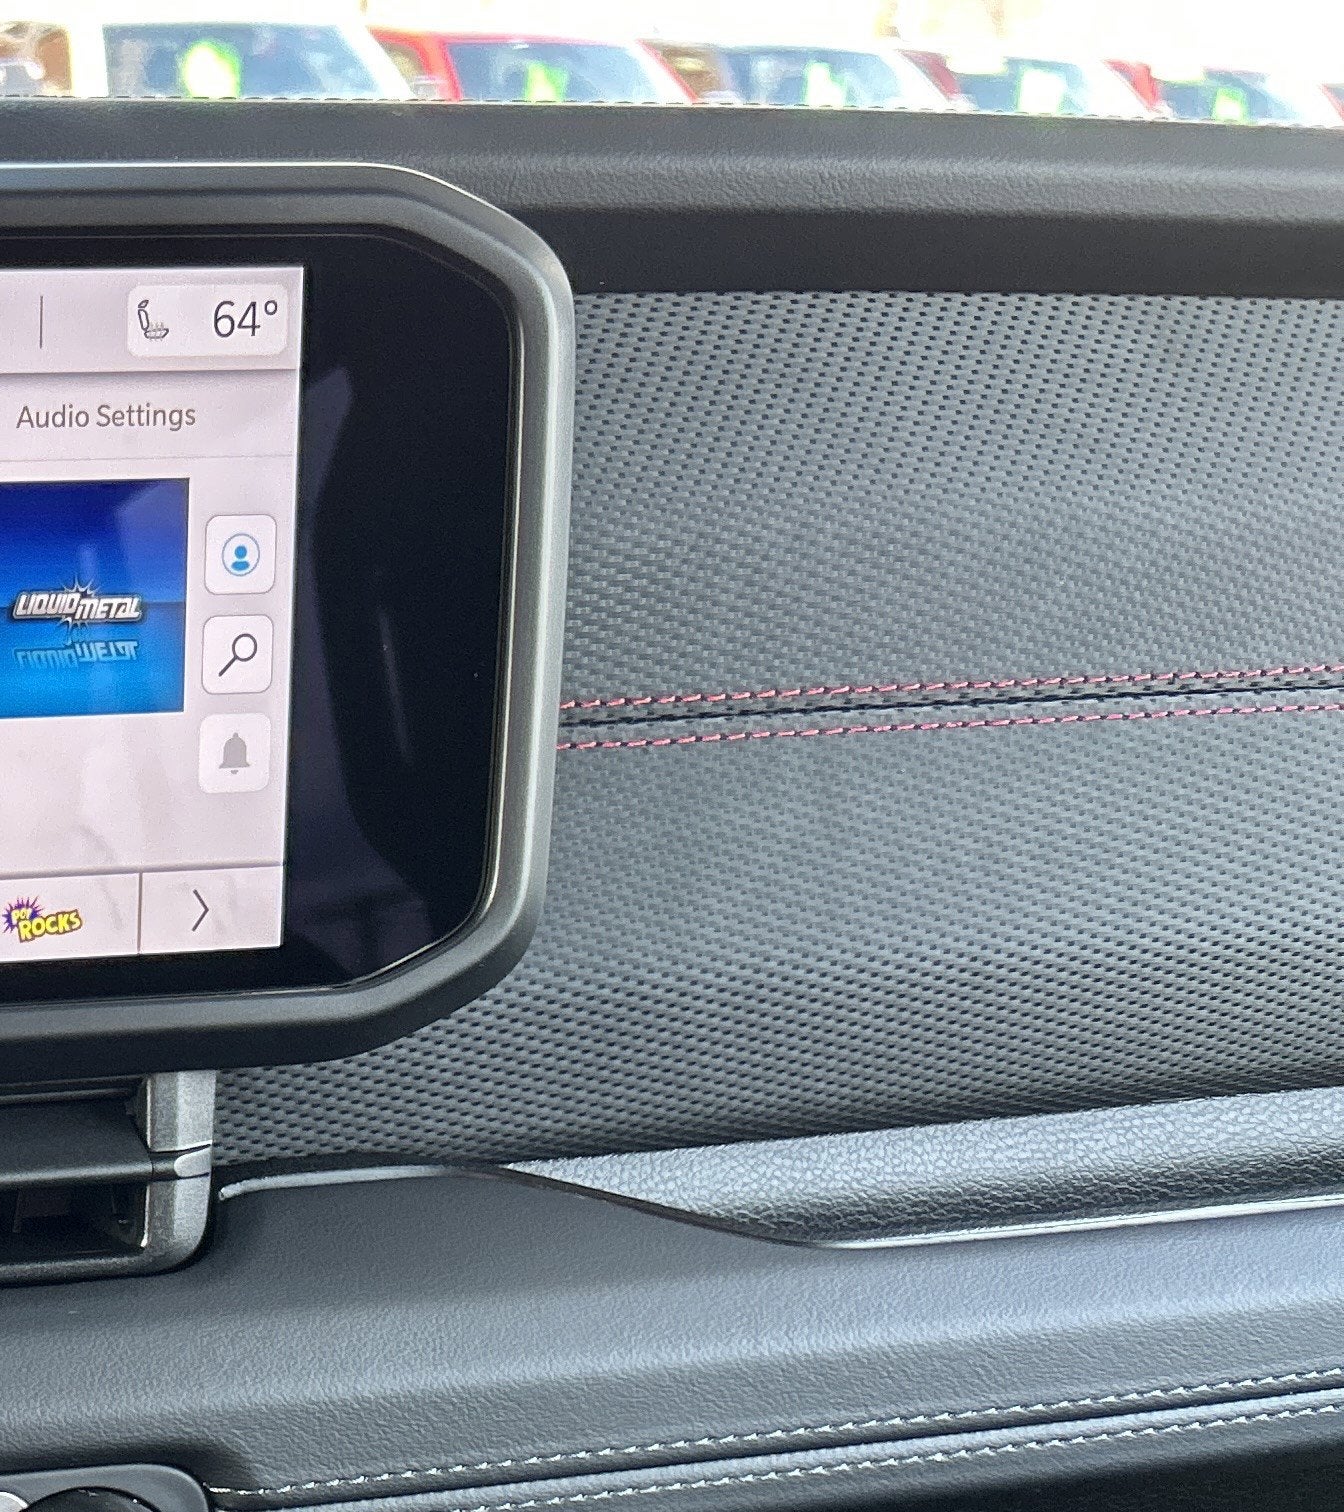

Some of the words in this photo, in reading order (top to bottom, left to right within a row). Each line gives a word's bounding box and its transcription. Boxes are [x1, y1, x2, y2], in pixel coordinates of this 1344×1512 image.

[212, 299, 278, 338] 64°
[16, 405, 90, 429] Audio
[96, 404, 196, 431] Settings
[16, 593, 80, 615] LIQUID
[75, 597, 141, 619] METAL
[18, 909, 82, 943] ROCKS
